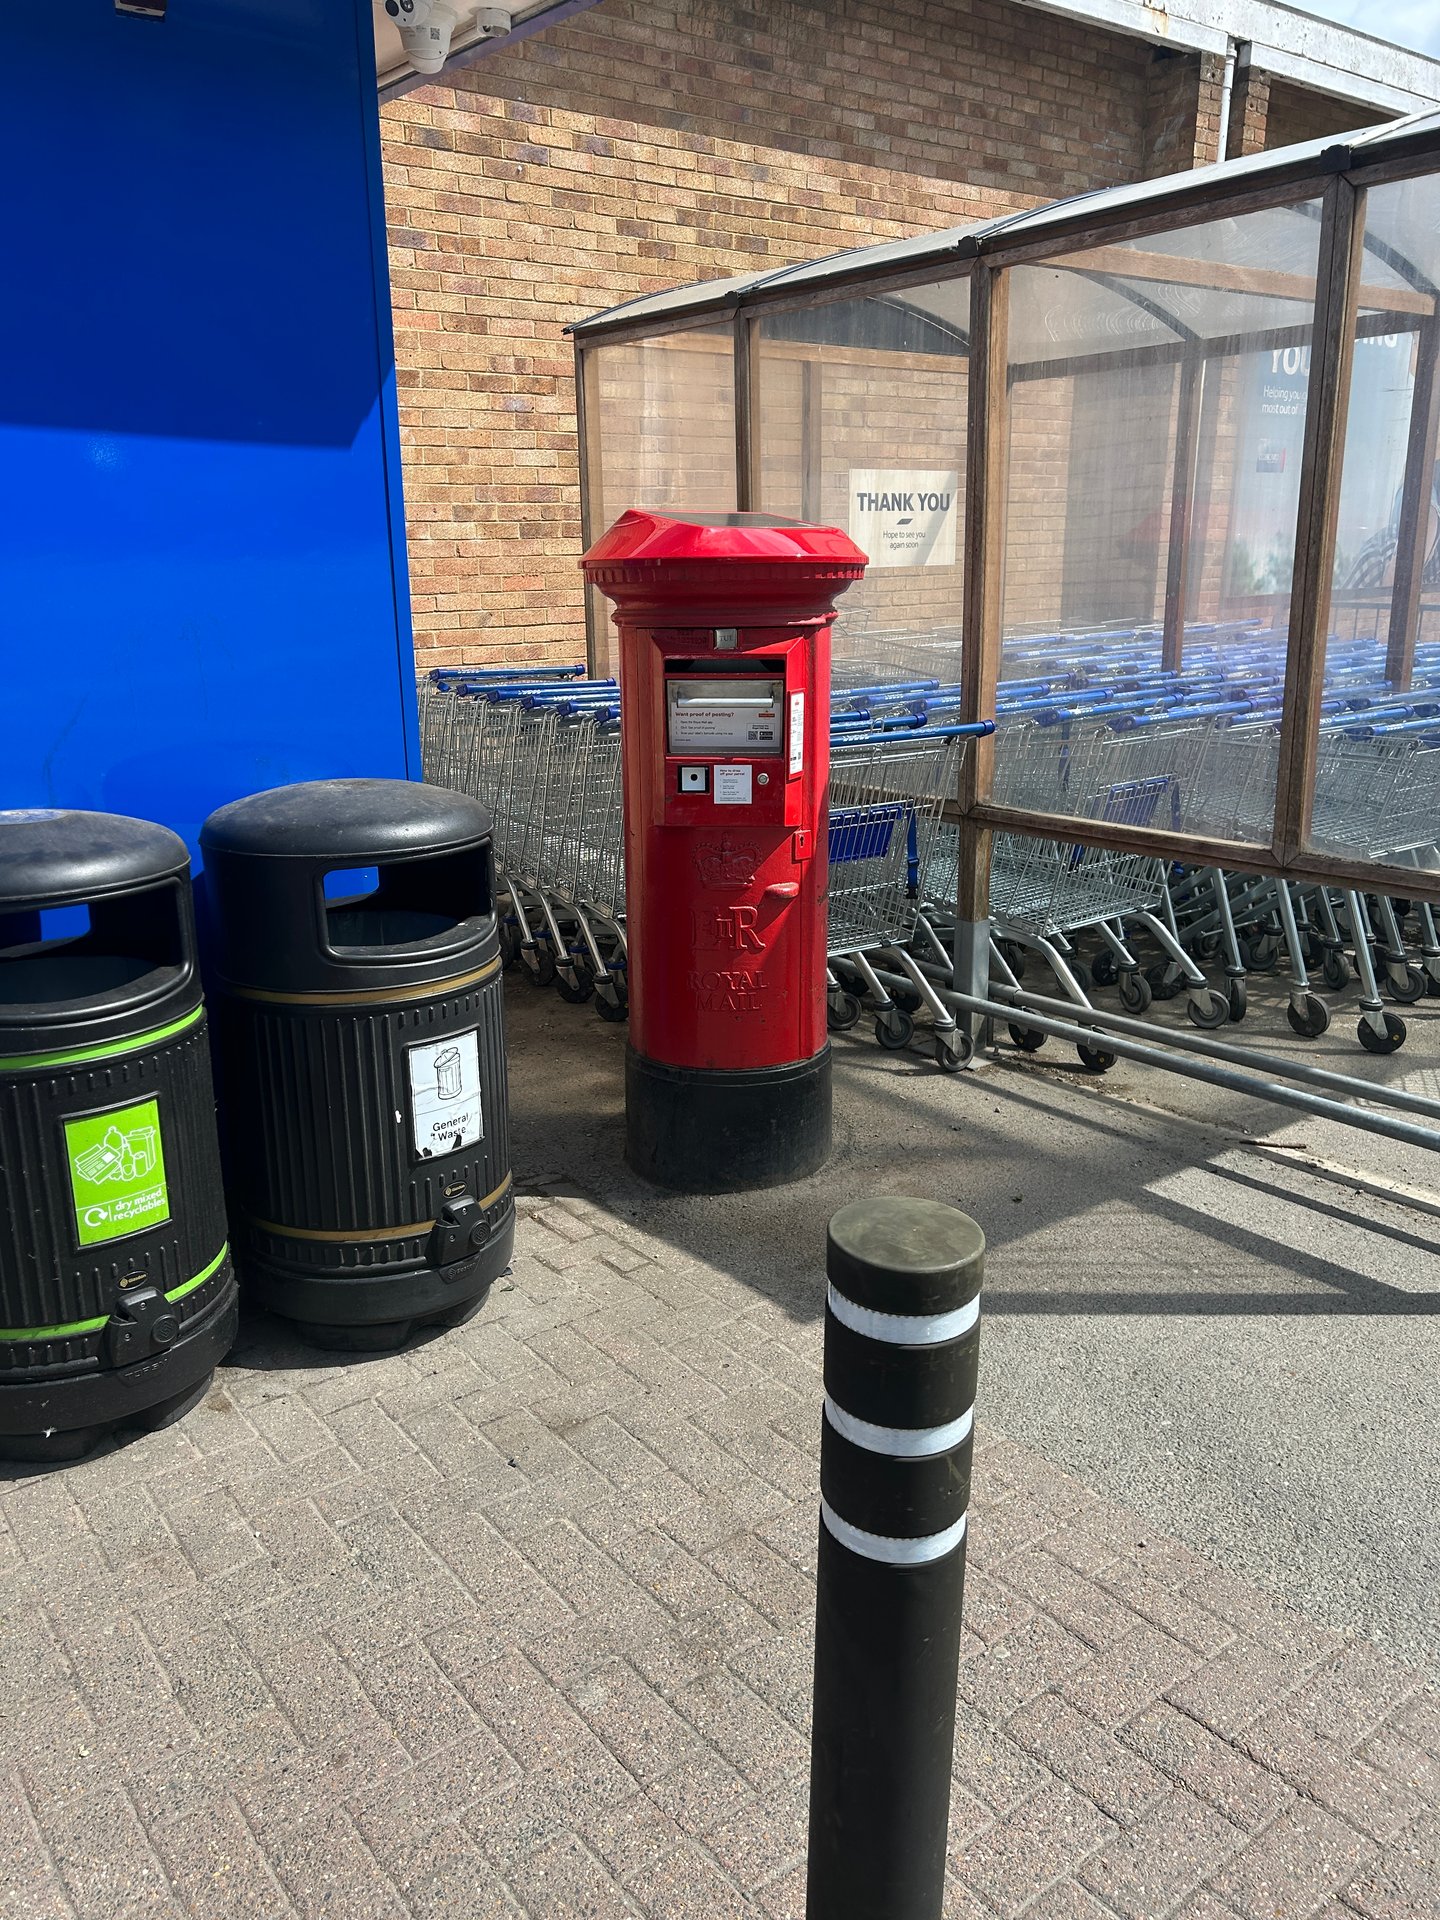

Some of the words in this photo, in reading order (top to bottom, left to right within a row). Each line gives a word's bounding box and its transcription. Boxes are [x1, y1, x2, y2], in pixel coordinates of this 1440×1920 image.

[1263, 386, 1288, 401] Helping
[1288, 391, 1300, 402] you
[1261, 404, 1279, 413] most
[1279, 405, 1291, 414] out
[857, 492, 914, 512] THANK
[918, 492, 950, 512] YOU
[883, 530, 898, 540] Hope
[898, 531, 905, 539] to
[915, 532, 926, 540] you
[889, 542, 905, 550] again
[688, 970, 769, 990] ROYAL
[696, 992, 762, 1011] MAIL
[432, 1112, 469, 1132] General
[437, 1126, 466, 1141] Waste
[115, 1200, 132, 1211] dry
[134, 1187, 162, 1205] mixed
[113, 1197, 165, 1221] recyclables
